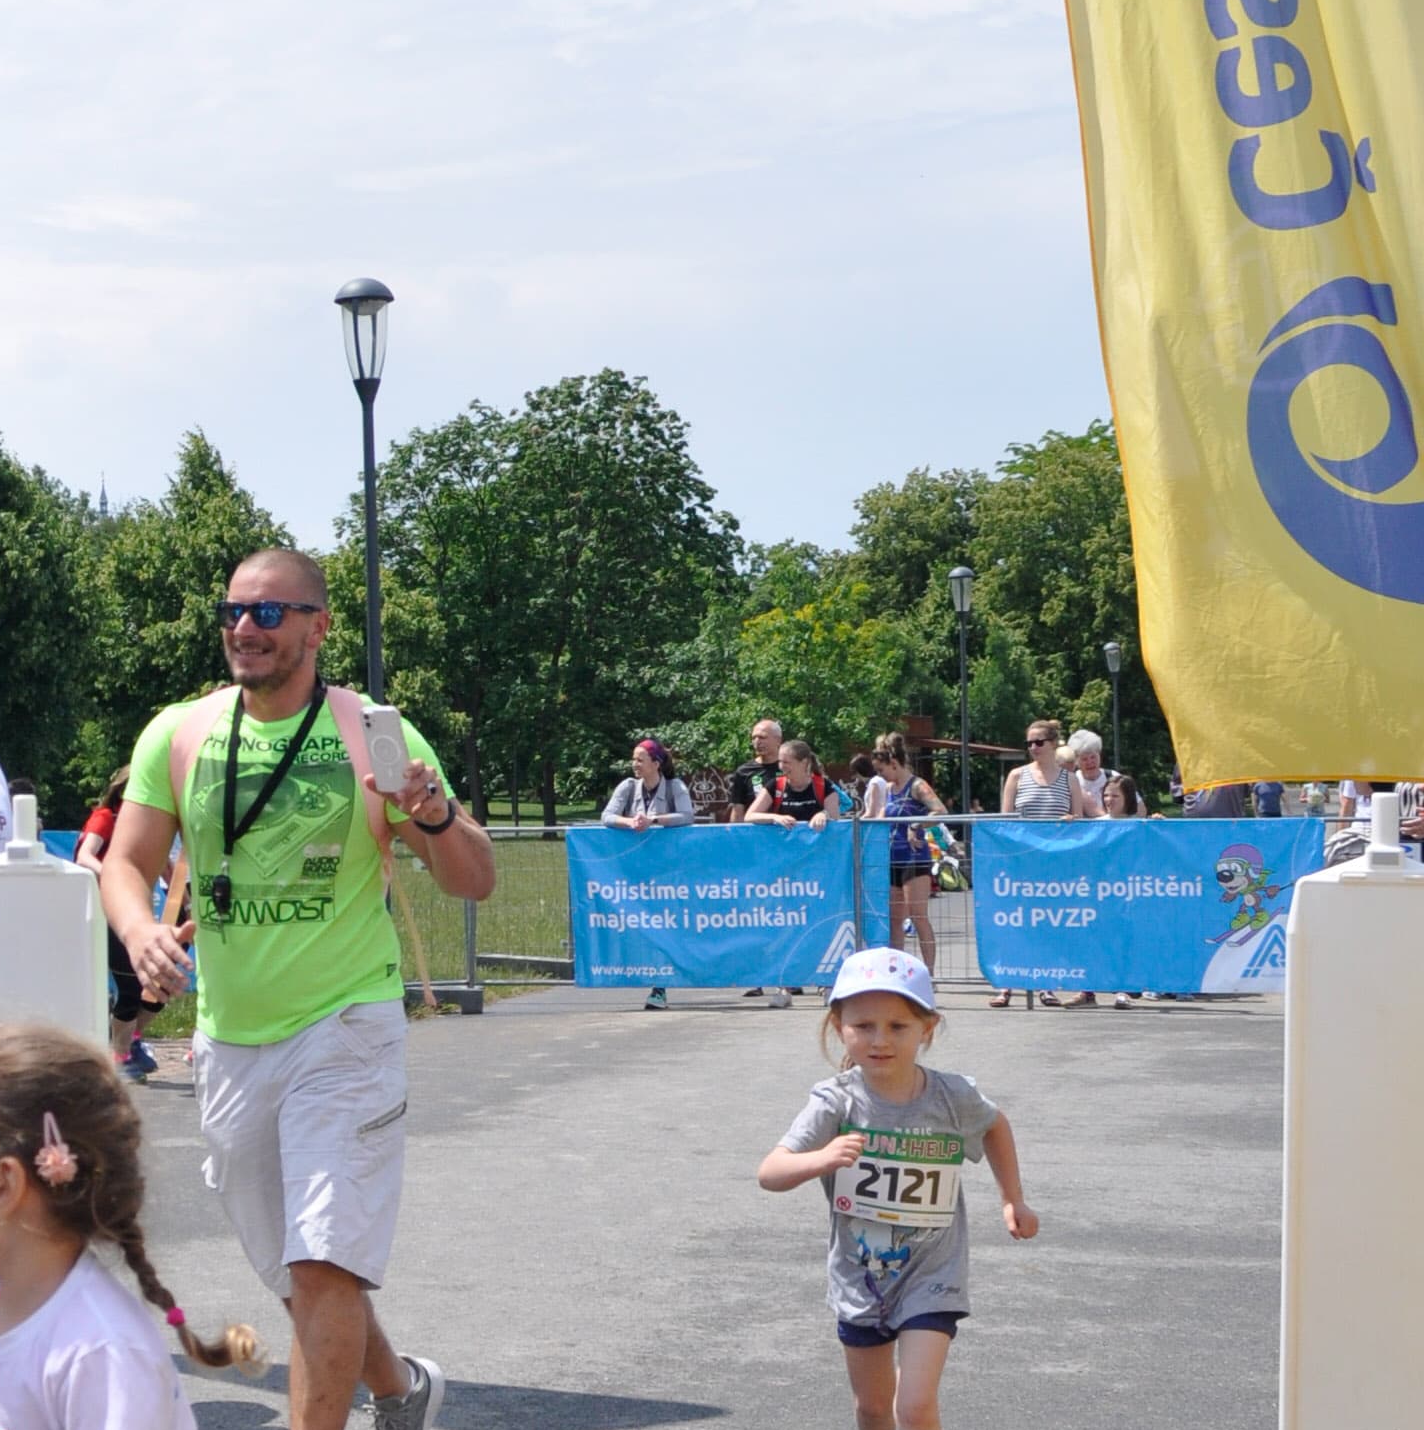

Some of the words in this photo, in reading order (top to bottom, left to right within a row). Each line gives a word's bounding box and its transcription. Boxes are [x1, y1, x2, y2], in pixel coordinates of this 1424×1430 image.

[586, 879, 689, 905] Pojistíme
[696, 878, 739, 900] vaši
[745, 877, 825, 900] rodinu,
[993, 871, 1091, 897] Úrazové
[1097, 875, 1203, 901] pojištění
[589, 908, 679, 933] majetek
[683, 908, 689, 928] i
[696, 905, 807, 933] podnikání
[993, 907, 1024, 927] od
[1031, 908, 1097, 927] PVZP
[591, 964, 674, 977] www.pvzp.cz
[994, 966, 1085, 979] www.pvzp.cz
[911, 1140, 961, 1160] HELP
[855, 1162, 941, 1206] 2121
